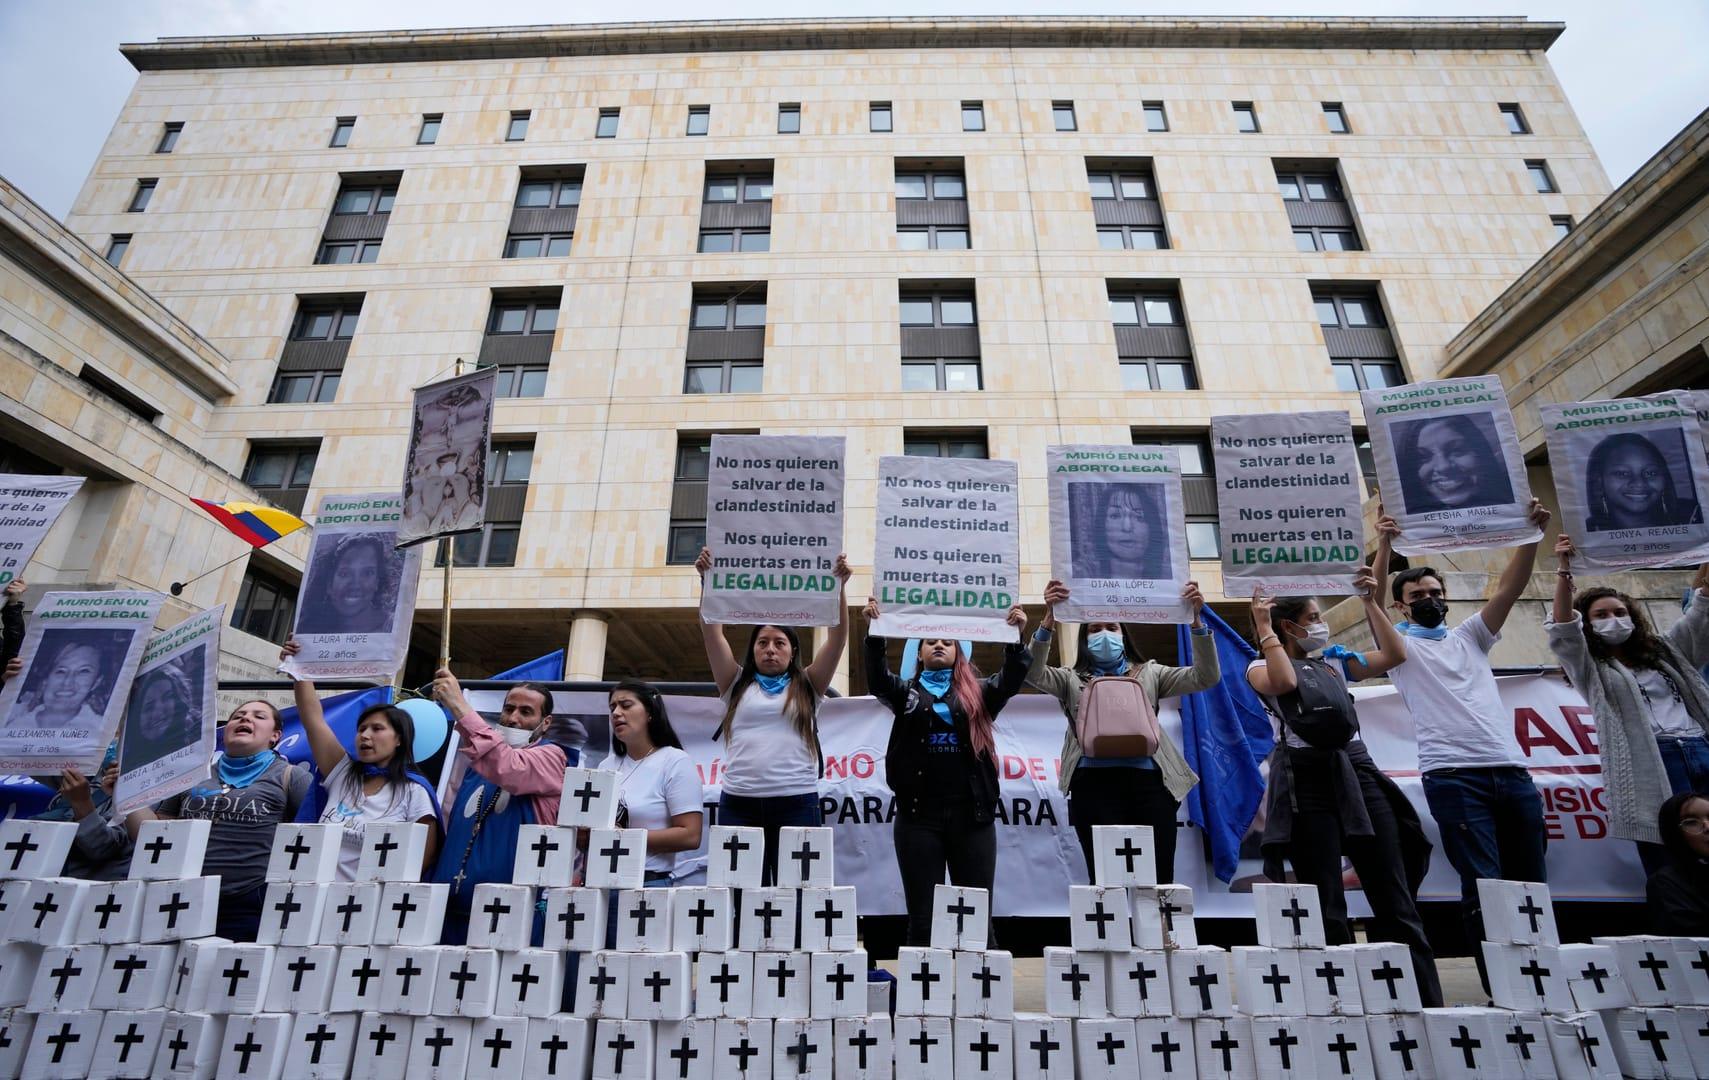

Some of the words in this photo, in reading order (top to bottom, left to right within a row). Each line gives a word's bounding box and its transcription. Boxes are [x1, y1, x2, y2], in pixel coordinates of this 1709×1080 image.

[1382, 388, 1435, 401] MURIÓ
[1438, 385, 1459, 394] EN
[1462, 383, 1485, 392] UN
[1375, 400, 1441, 415] ABORTO
[1444, 394, 1498, 406] LEGAL
[1562, 403, 1619, 417] MURIÓ
[1623, 402, 1647, 410] EN
[1652, 398, 1677, 407] UN
[1554, 415, 1628, 430] ABORTO
[1631, 409, 1690, 422] LEGAL
[1220, 437, 1243, 448] No
[1248, 437, 1277, 447] nos
[1281, 433, 1346, 448] quieren
[1066, 450, 1115, 460] MURIÓ
[1240, 456, 1291, 468] salvar
[1296, 453, 1315, 465] de
[1320, 453, 1335, 465] la
[716, 456, 738, 468] No
[743, 459, 771, 469] nos
[775, 457, 839, 472] quieren
[1056, 465, 1119, 473] ABORTO
[1122, 465, 1173, 473] LEGAL
[731, 478, 781, 491] salvar
[786, 478, 805, 491] de
[810, 478, 825, 491] la
[885, 476, 908, 488] No
[912, 479, 942, 489] nos
[946, 479, 1010, 493] quieren
[1225, 473, 1350, 489] clandestinidad
[12, 488, 68, 498] quieren
[11, 502, 29, 512] de
[31, 502, 46, 512] la
[325, 499, 370, 511] MURIÓ
[373, 500, 393, 508] EN
[715, 499, 836, 513] clandestinidad
[902, 496, 953, 509] salvar
[958, 498, 977, 511] de
[982, 499, 997, 511] la
[316, 514, 370, 524] ABORTO
[1239, 508, 1273, 520] Nos
[1278, 506, 1346, 523] quieren
[1424, 511, 1462, 521] KEISHA
[1468, 507, 1499, 517] MARIE
[884, 515, 1009, 532] clandestinidad
[724, 532, 756, 545] Nos
[761, 532, 828, 549] quieren
[1232, 529, 1306, 543] muertas
[1311, 529, 1332, 540] en
[1338, 527, 1353, 540] la
[1608, 530, 1642, 540] TONYA
[1648, 526, 1689, 536] REAVES
[2, 557, 18, 567] la
[894, 547, 928, 560] Nos
[933, 549, 1001, 564] quieren
[1232, 545, 1359, 565] LEGALIDAD
[714, 556, 786, 569] muertas
[790, 559, 811, 569] en
[817, 556, 832, 570] la
[712, 573, 836, 591] LEGALIDAD
[883, 570, 959, 584] muertas
[964, 575, 986, 586] en
[992, 573, 1007, 587] la
[1091, 581, 1120, 589] DIANA
[1126, 580, 1154, 589] LÓPEZ
[57, 597, 103, 606] MURIÓ
[882, 586, 1012, 609] LEGALIDAD
[40, 611, 99, 619] ABORTO
[101, 611, 149, 619] LEGAL
[175, 624, 214, 647] LEGAL
[313, 635, 340, 644] LAURA
[345, 634, 368, 643] HOPE
[319, 650, 329, 659] 22
[334, 650, 357, 659] años
[7, 730, 56, 738] ALEXANDRA
[825, 753, 875, 780] NO
[994, 798, 1058, 826] ARA
